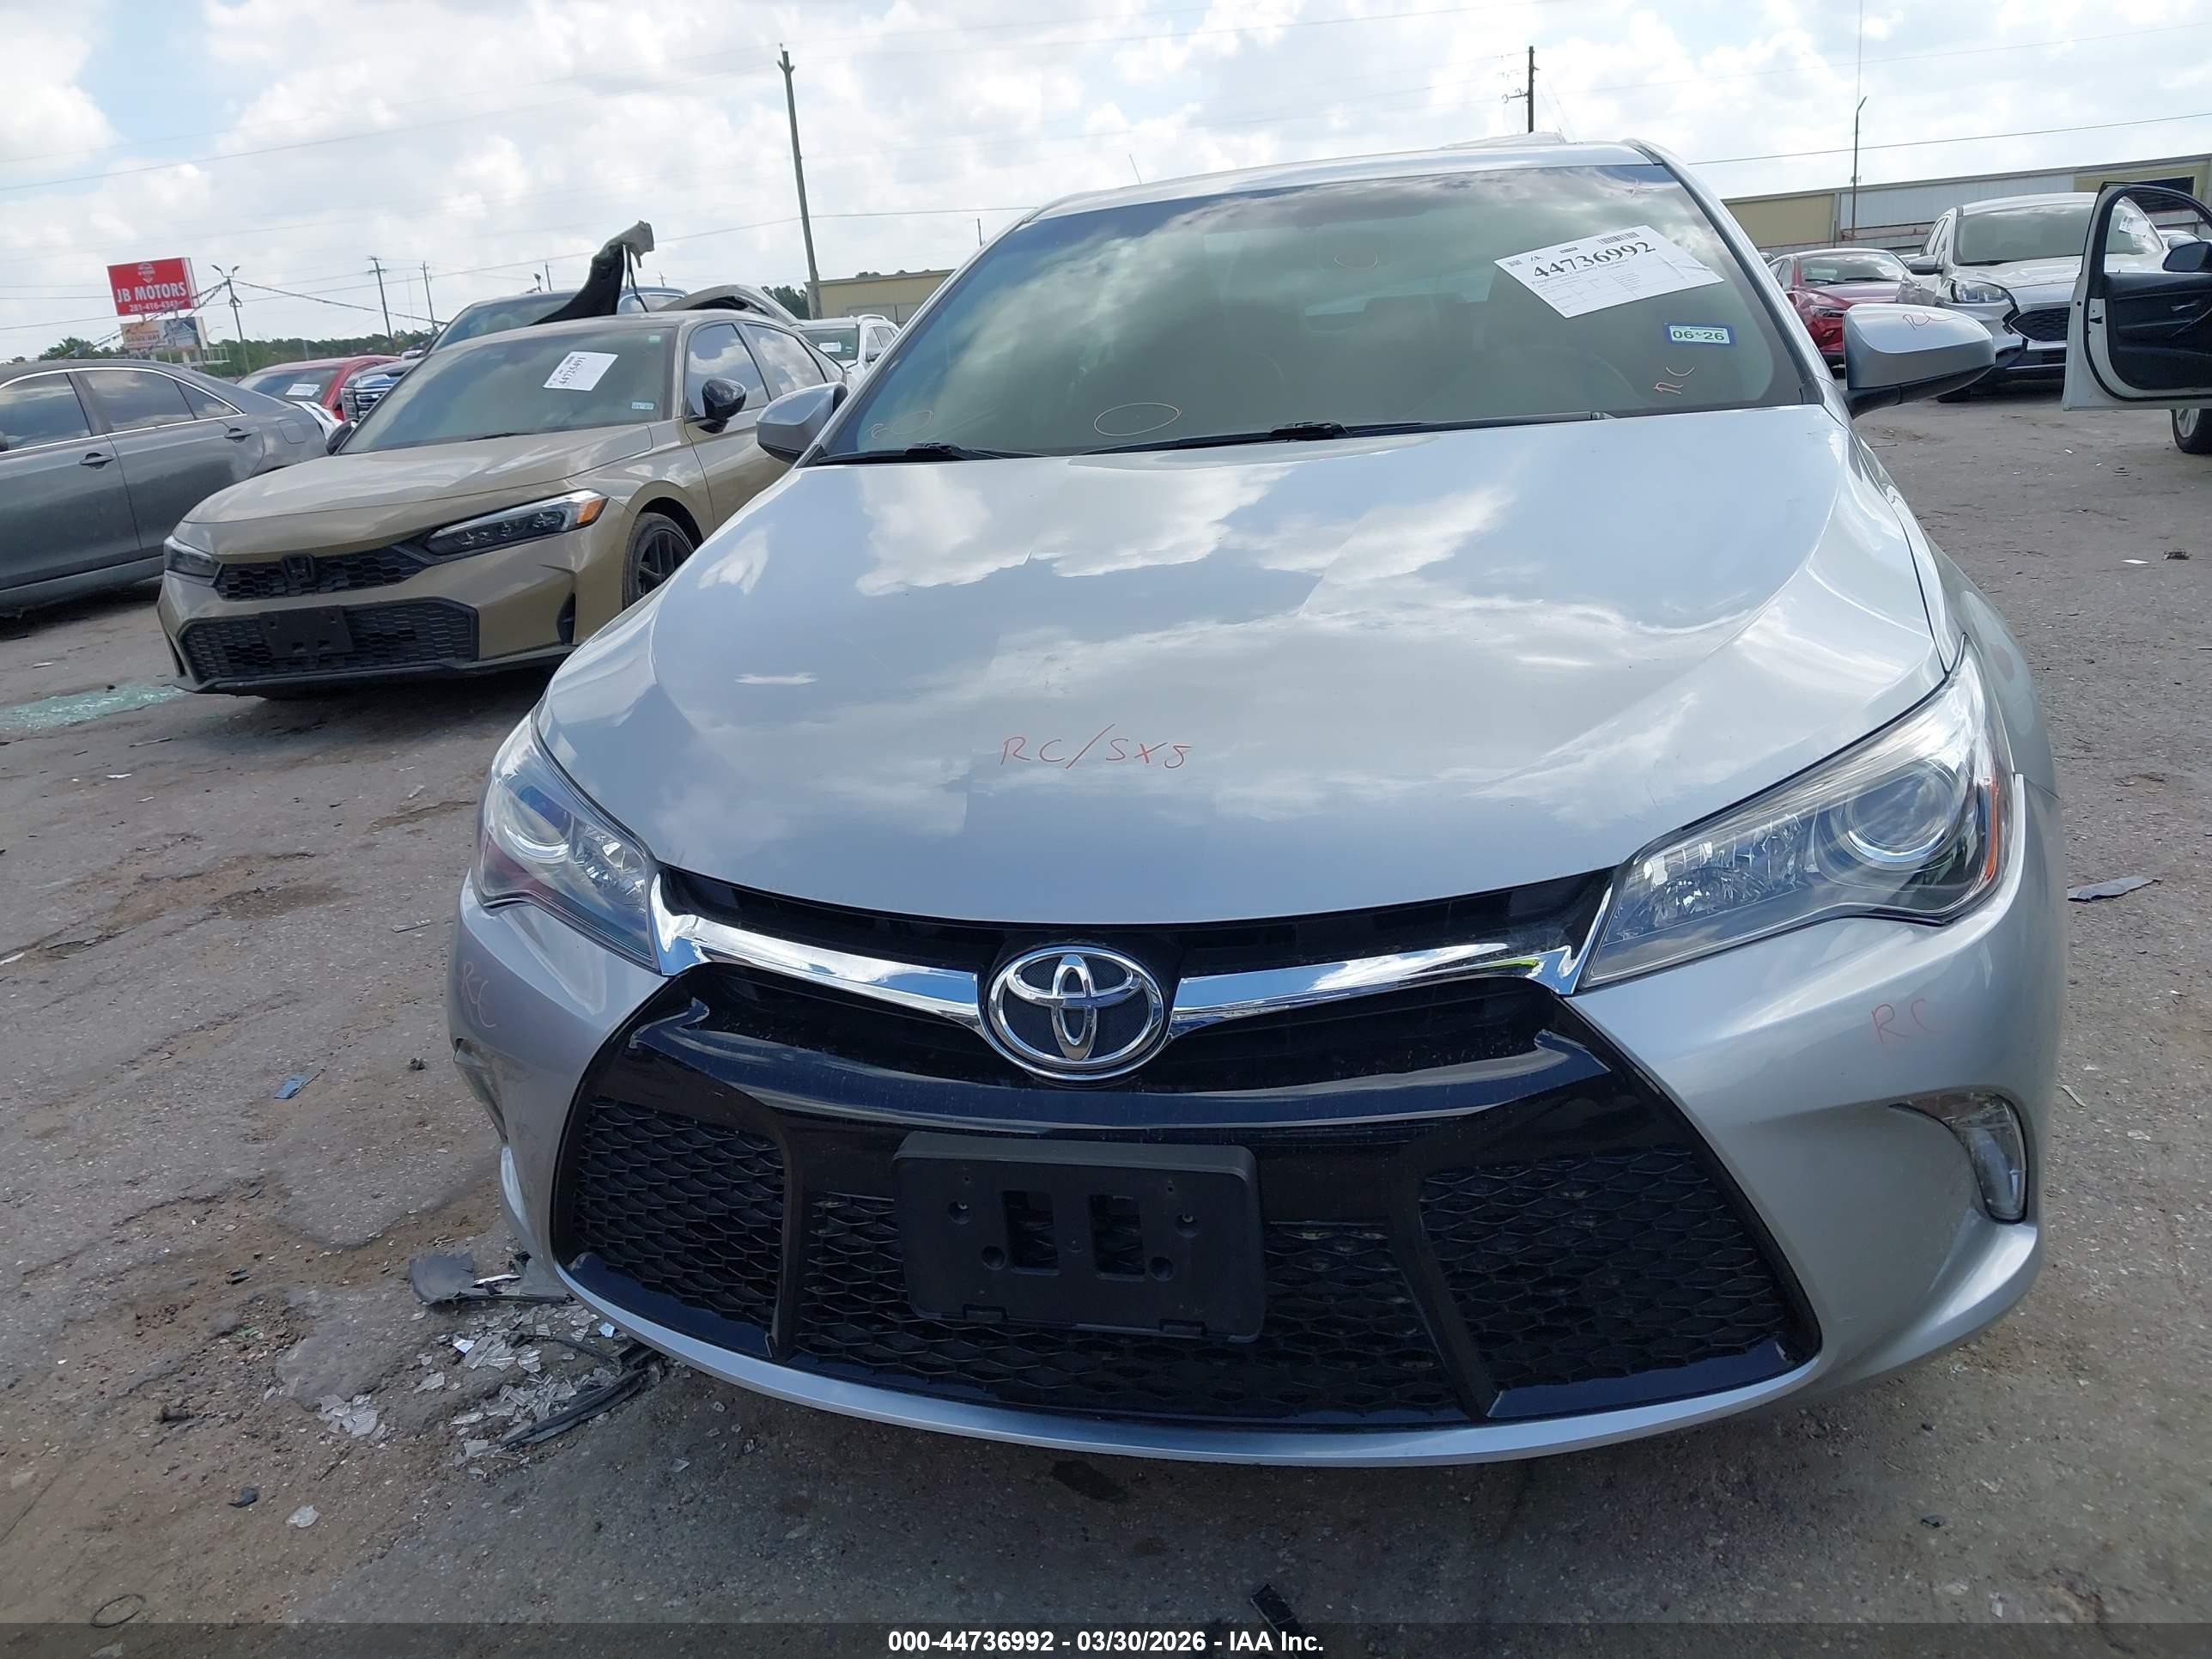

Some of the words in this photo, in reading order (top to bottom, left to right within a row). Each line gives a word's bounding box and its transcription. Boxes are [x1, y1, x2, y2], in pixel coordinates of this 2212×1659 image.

[1534, 241, 1656, 277] 44736992
[117, 288, 131, 303] JB
[134, 282, 186, 301] MOTORS
[1870, 998, 1936, 1045] RC
